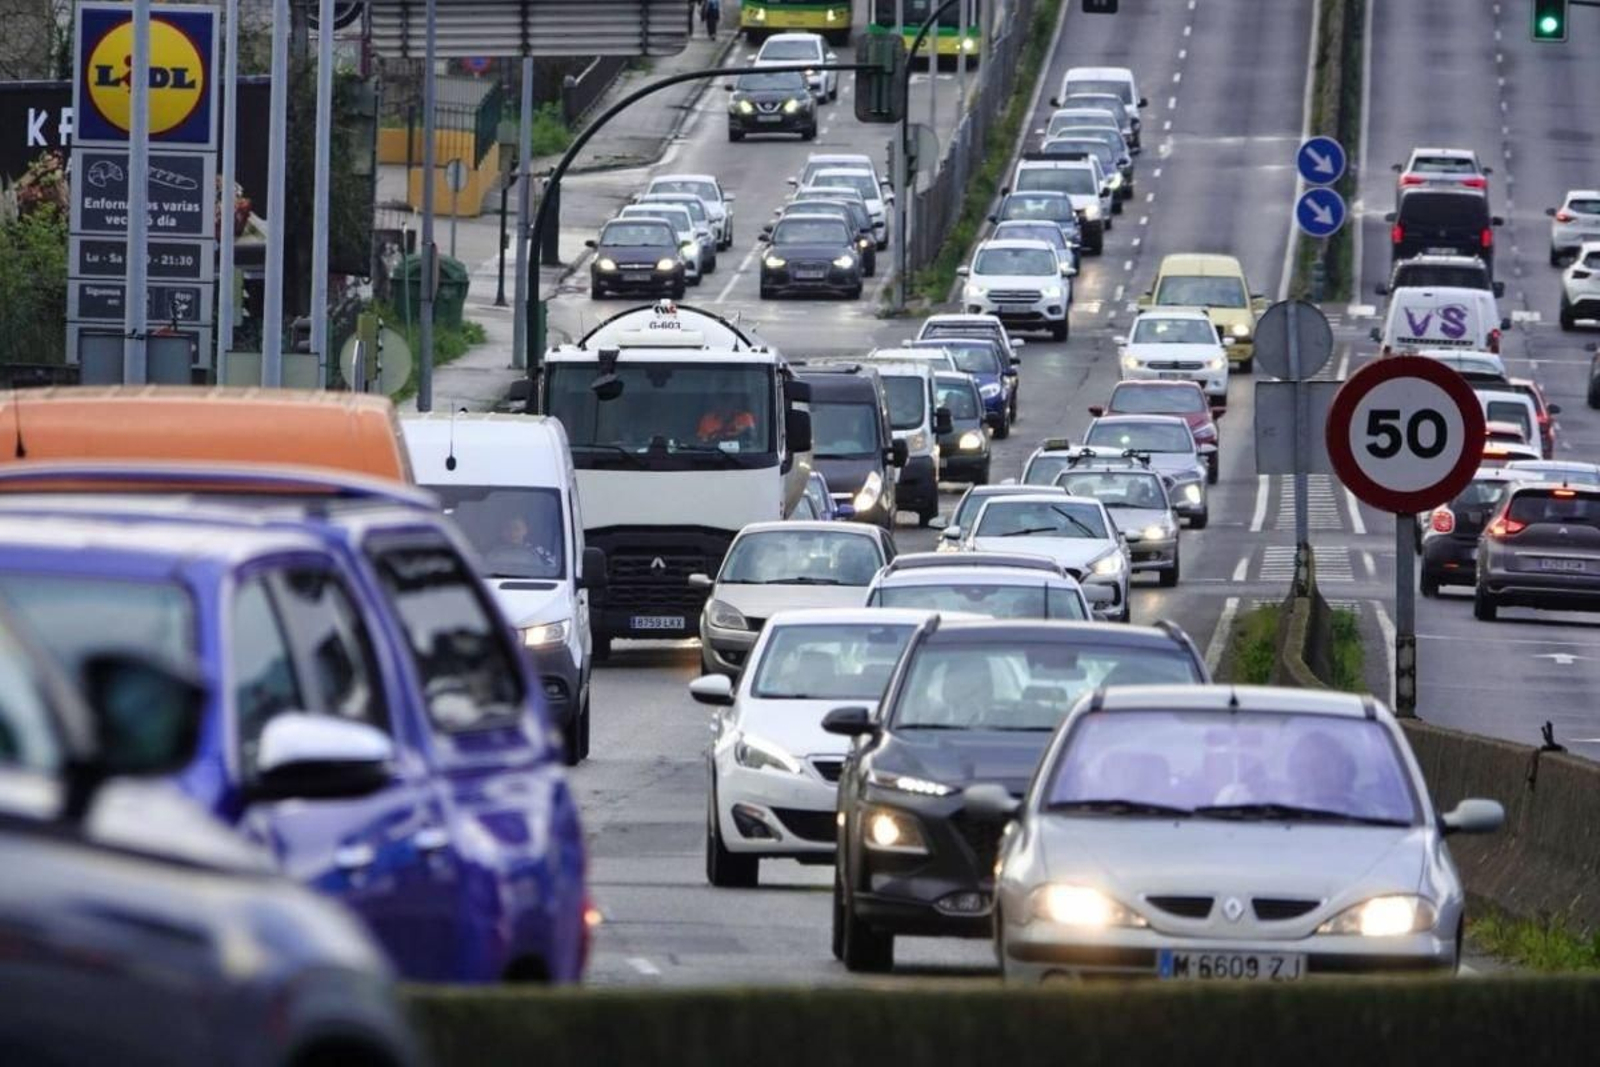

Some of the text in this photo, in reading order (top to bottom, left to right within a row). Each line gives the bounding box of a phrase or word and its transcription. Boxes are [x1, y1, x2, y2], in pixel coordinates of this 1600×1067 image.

[84, 197, 200, 212] Enfornos varias
[157, 215, 177, 227] día
[161, 255, 193, 267] 21:30
[1404, 303, 1468, 339] VS
[1366, 408, 1448, 459] 50
